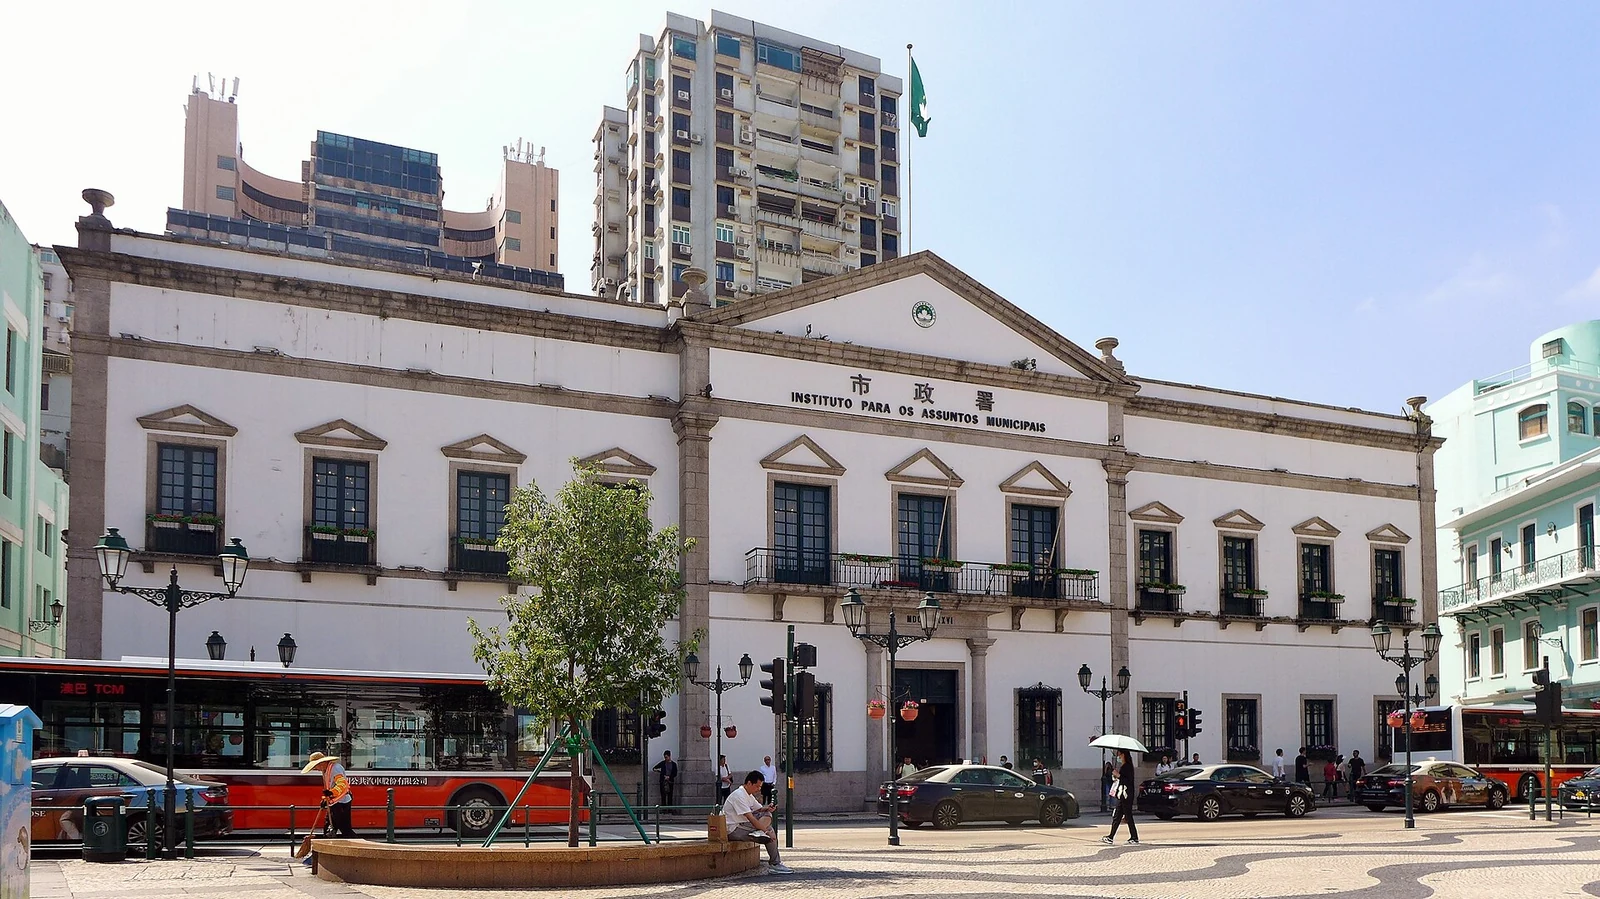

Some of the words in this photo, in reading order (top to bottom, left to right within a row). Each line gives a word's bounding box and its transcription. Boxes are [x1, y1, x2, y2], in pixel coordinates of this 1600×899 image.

[791, 391, 853, 409] INSTITUTO
[861, 400, 891, 414] PARA
[899, 405, 914, 417] OS
[921, 408, 979, 424] ASSUNTOS
[986, 416, 1046, 433] MUNICIPAIS
[94, 684, 125, 695] TCM
